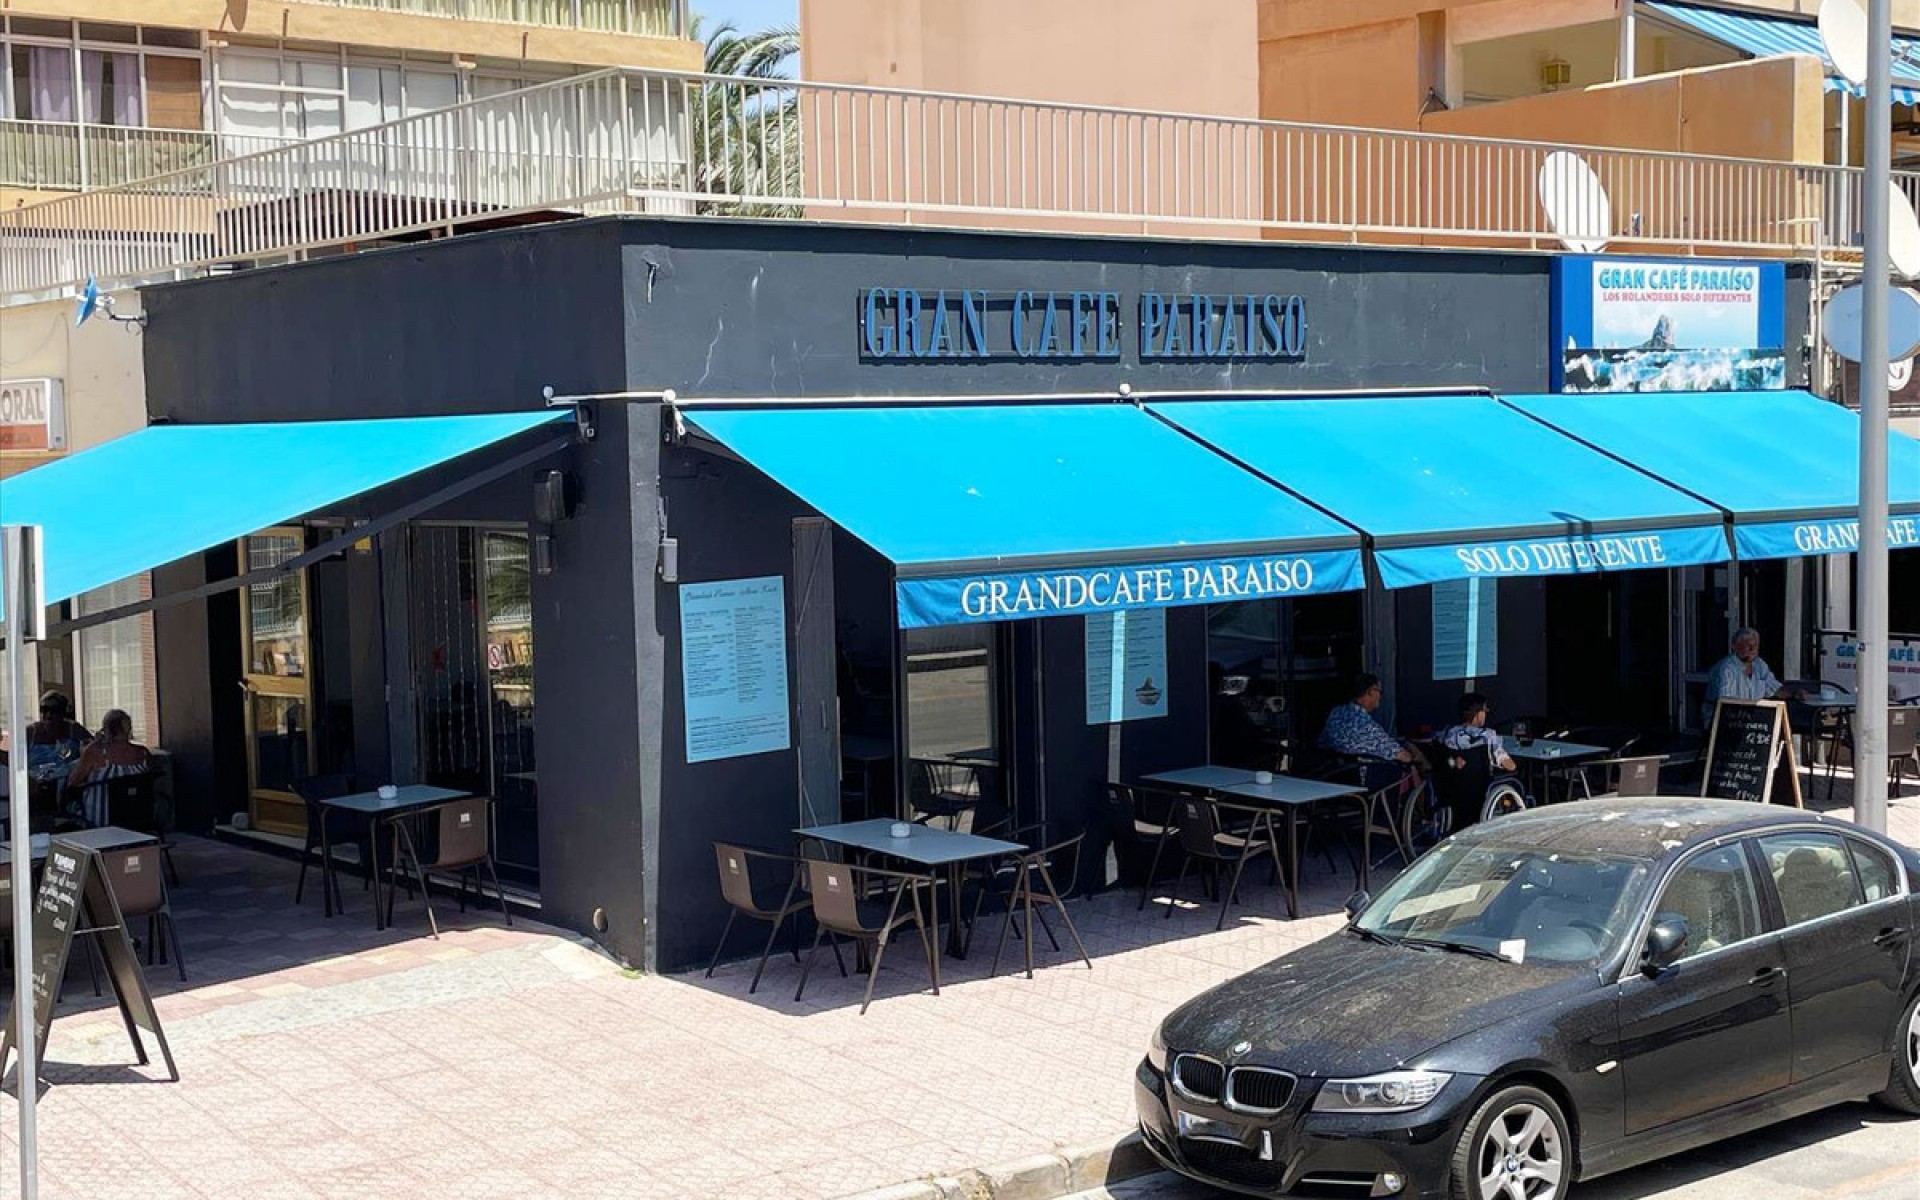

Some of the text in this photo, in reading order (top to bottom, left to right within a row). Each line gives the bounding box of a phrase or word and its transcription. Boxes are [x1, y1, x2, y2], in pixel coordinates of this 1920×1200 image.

[1599, 266, 1754, 292] GRAN CAFÉ PARAÍSO
[1602, 292, 1620, 302] LOS
[1680, 293, 1702, 303] SOLO
[1703, 293, 1753, 303] DIFERENTES
[863, 287, 1306, 357] GRAN CAFE PARAISO
[1456, 535, 1665, 573] SOLO DIFERENTE
[961, 558, 1313, 617] GRANDCAFE PARAISO
